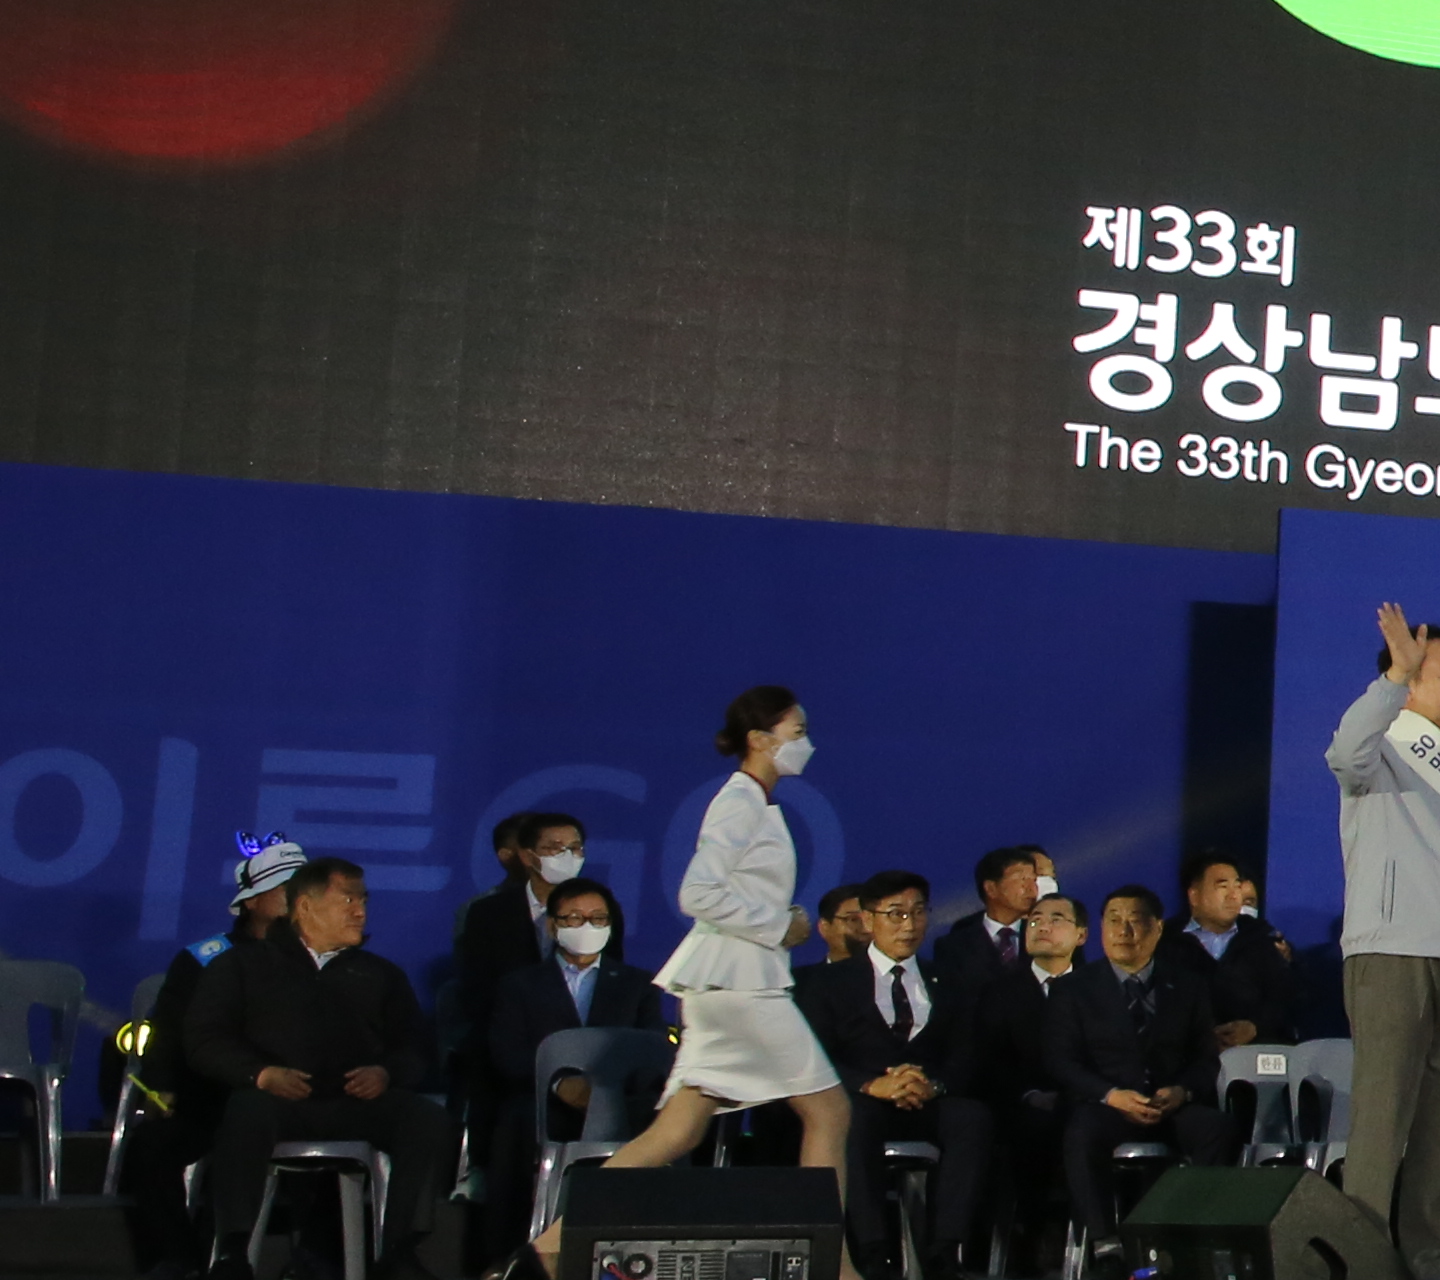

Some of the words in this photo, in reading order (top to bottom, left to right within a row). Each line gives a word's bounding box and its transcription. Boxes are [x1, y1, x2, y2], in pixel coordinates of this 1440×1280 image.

[1082, 204, 1296, 288] 제33회
[1064, 422, 1163, 474] The
[1177, 433, 1289, 485] 33th
